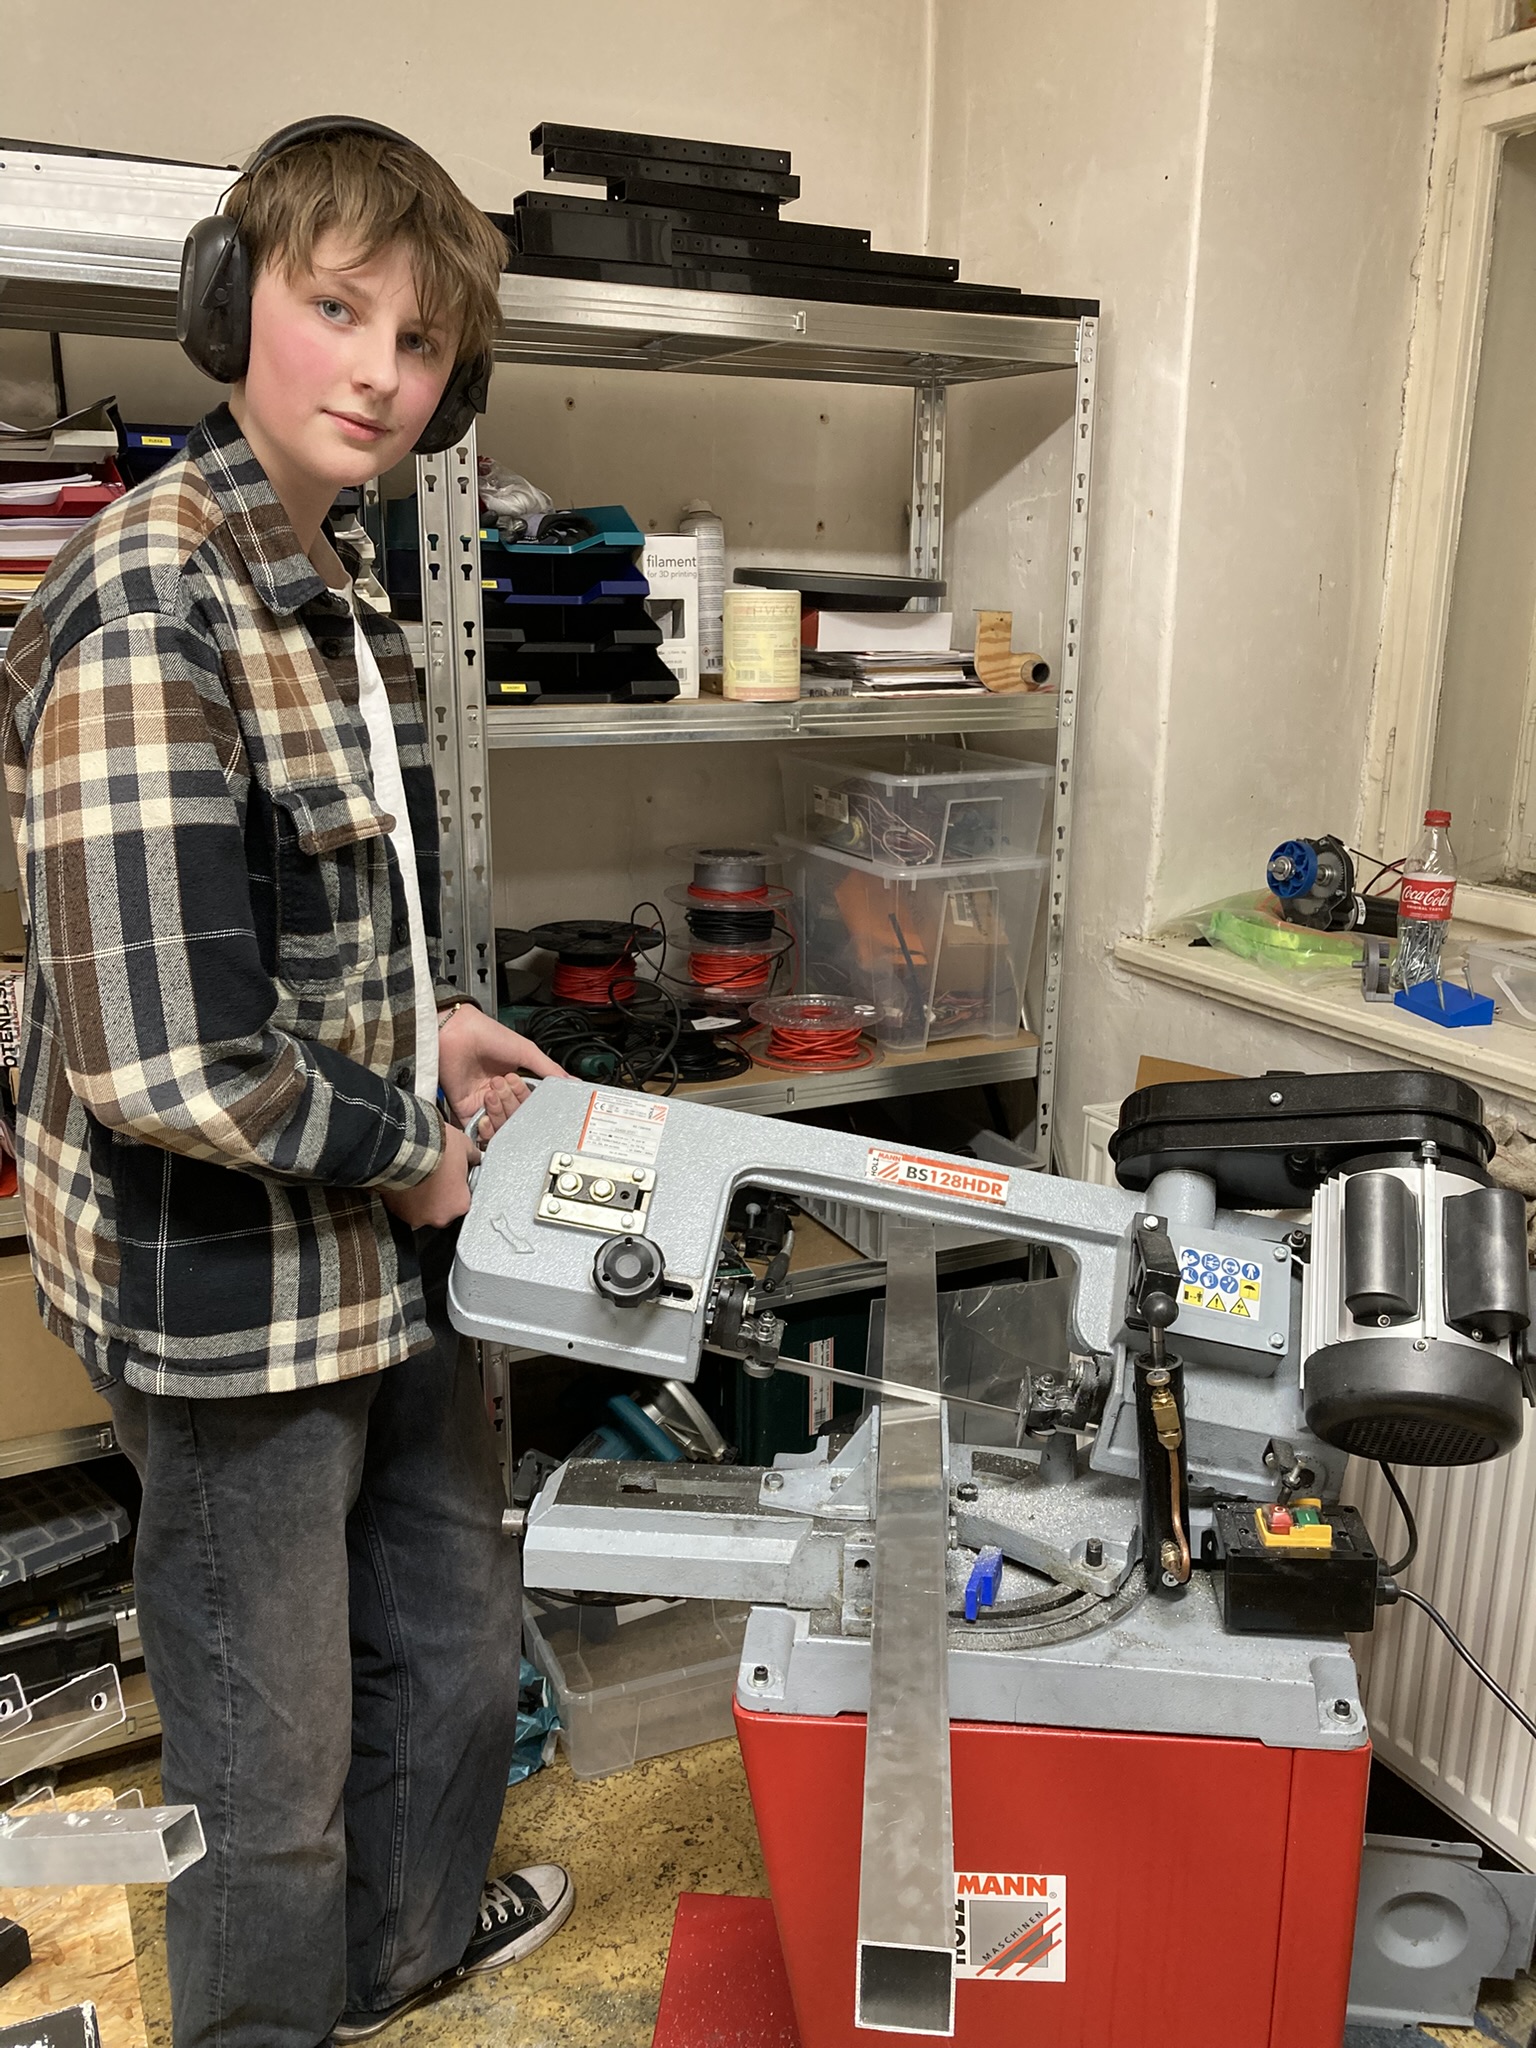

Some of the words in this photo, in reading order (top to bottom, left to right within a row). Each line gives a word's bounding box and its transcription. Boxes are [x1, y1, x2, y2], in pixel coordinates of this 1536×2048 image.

[646, 554, 697, 567] filament
[647, 570, 658, 578] for
[659, 570, 669, 578] 3D
[670, 570, 698, 580] printing
[1402, 885, 1452, 906] Coca-Cola
[878, 1153, 901, 1162] MANN
[906, 1166, 1003, 1196] BS128HDR
[957, 1875, 1048, 1896] MANN
[982, 1911, 1043, 1961] MASCHINEN
